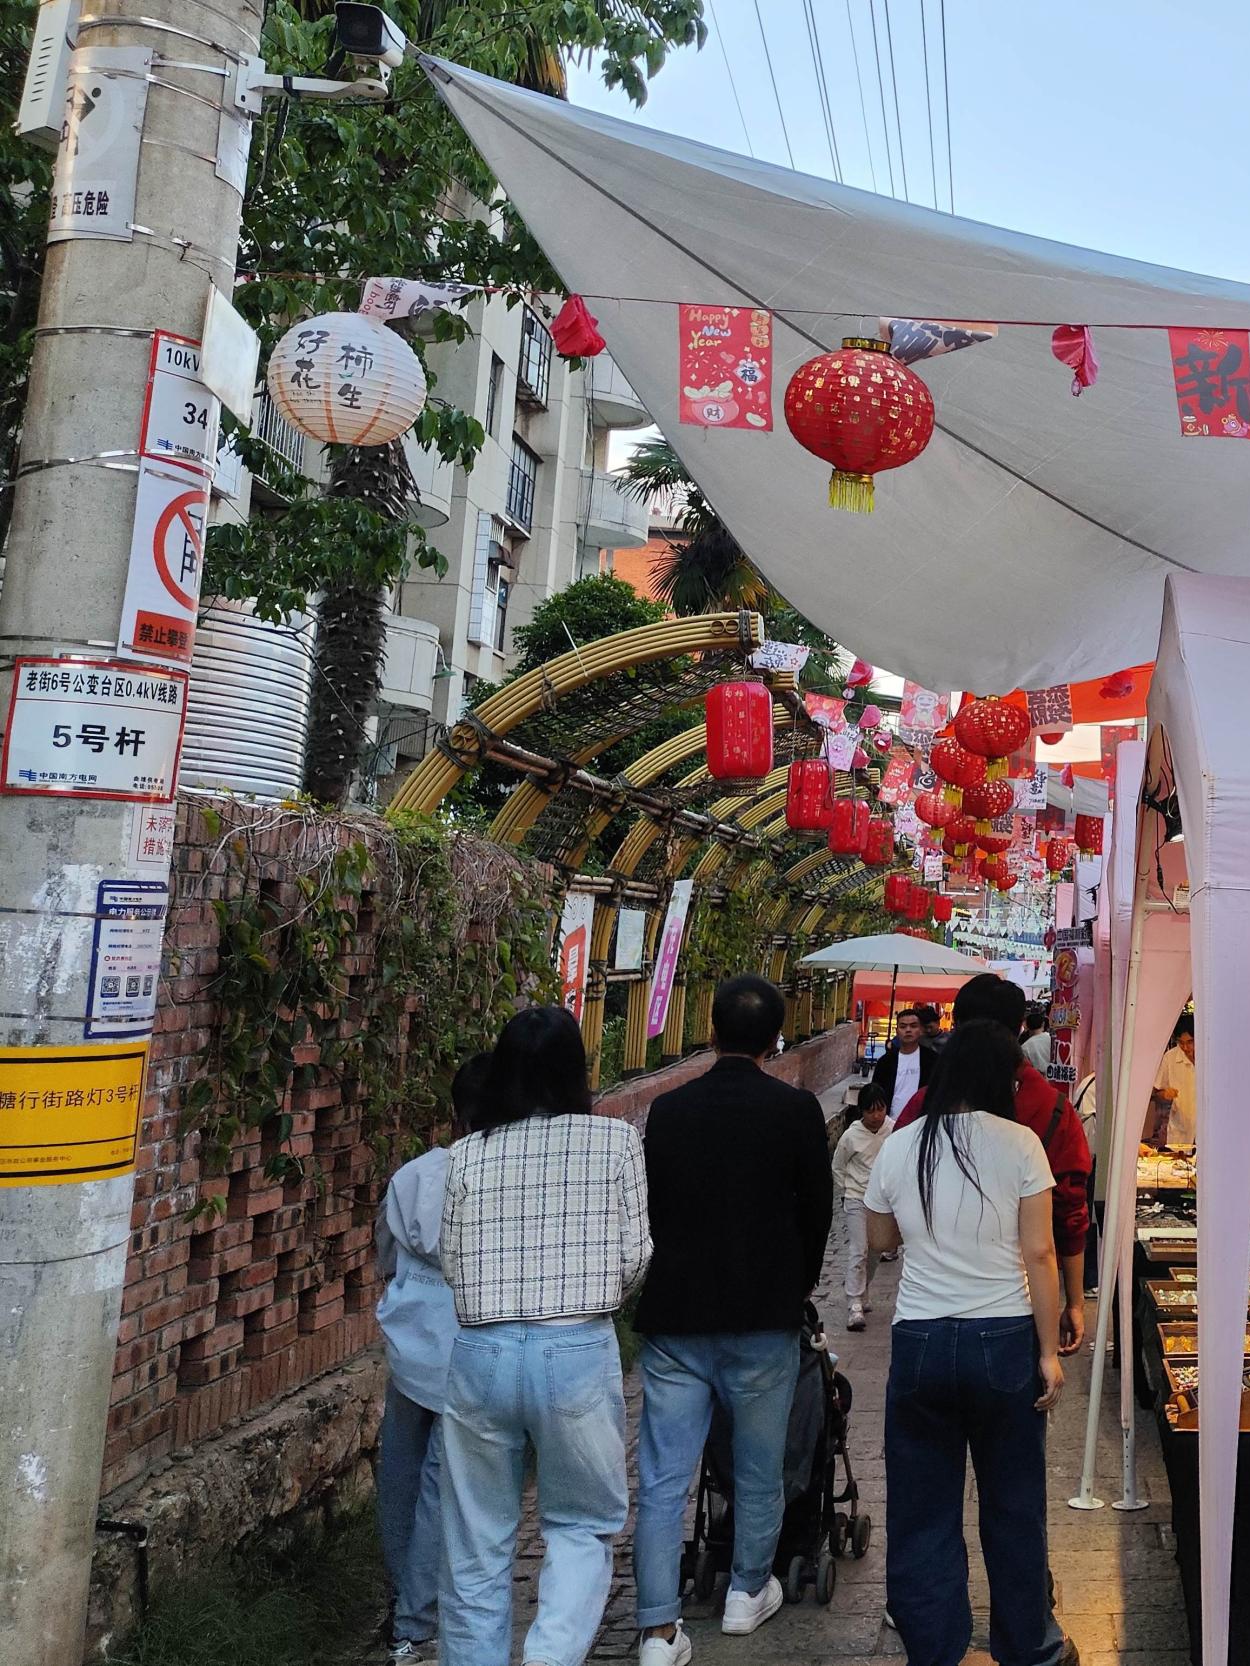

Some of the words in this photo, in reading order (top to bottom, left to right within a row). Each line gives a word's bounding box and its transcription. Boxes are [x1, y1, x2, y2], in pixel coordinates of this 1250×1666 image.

[689, 309, 729, 329] Happy
[702, 325, 731, 337] New
[691, 330, 722, 349] Year
[166, 347, 200, 372] 10kV
[182, 402, 208, 430] 34
[138, 624, 190, 650] 禁止攀登
[26, 669, 178, 706] 老街6号公变台区0.4kV线路
[52, 723, 146, 757] 5号杆
[38, 771, 98, 783] 中国南方电网
